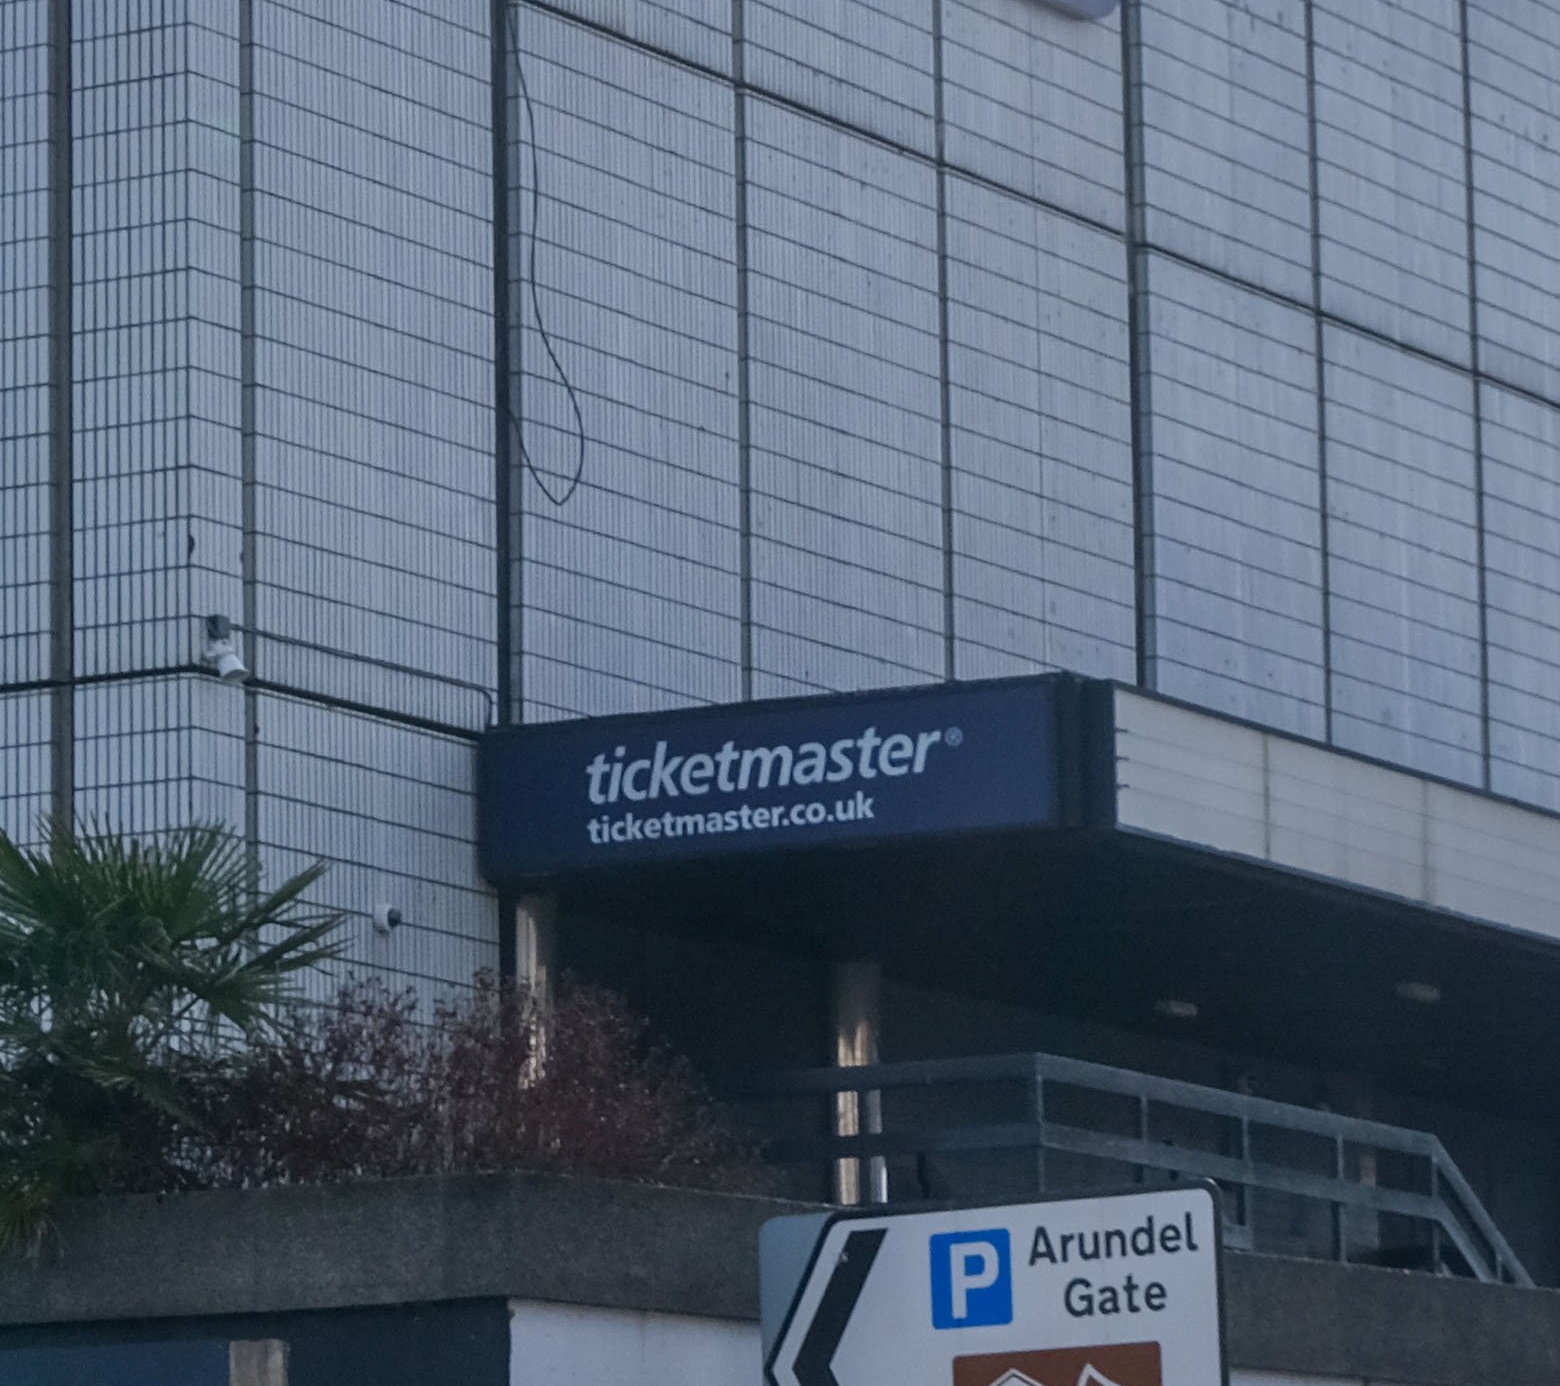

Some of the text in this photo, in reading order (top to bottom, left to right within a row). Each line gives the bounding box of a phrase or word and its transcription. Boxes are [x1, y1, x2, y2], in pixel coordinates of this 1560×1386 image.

[587, 791, 875, 845] ticketmaster.co.uk
[949, 1211, 1199, 1320] P Arundel
[1063, 1273, 1168, 1317] Gate
